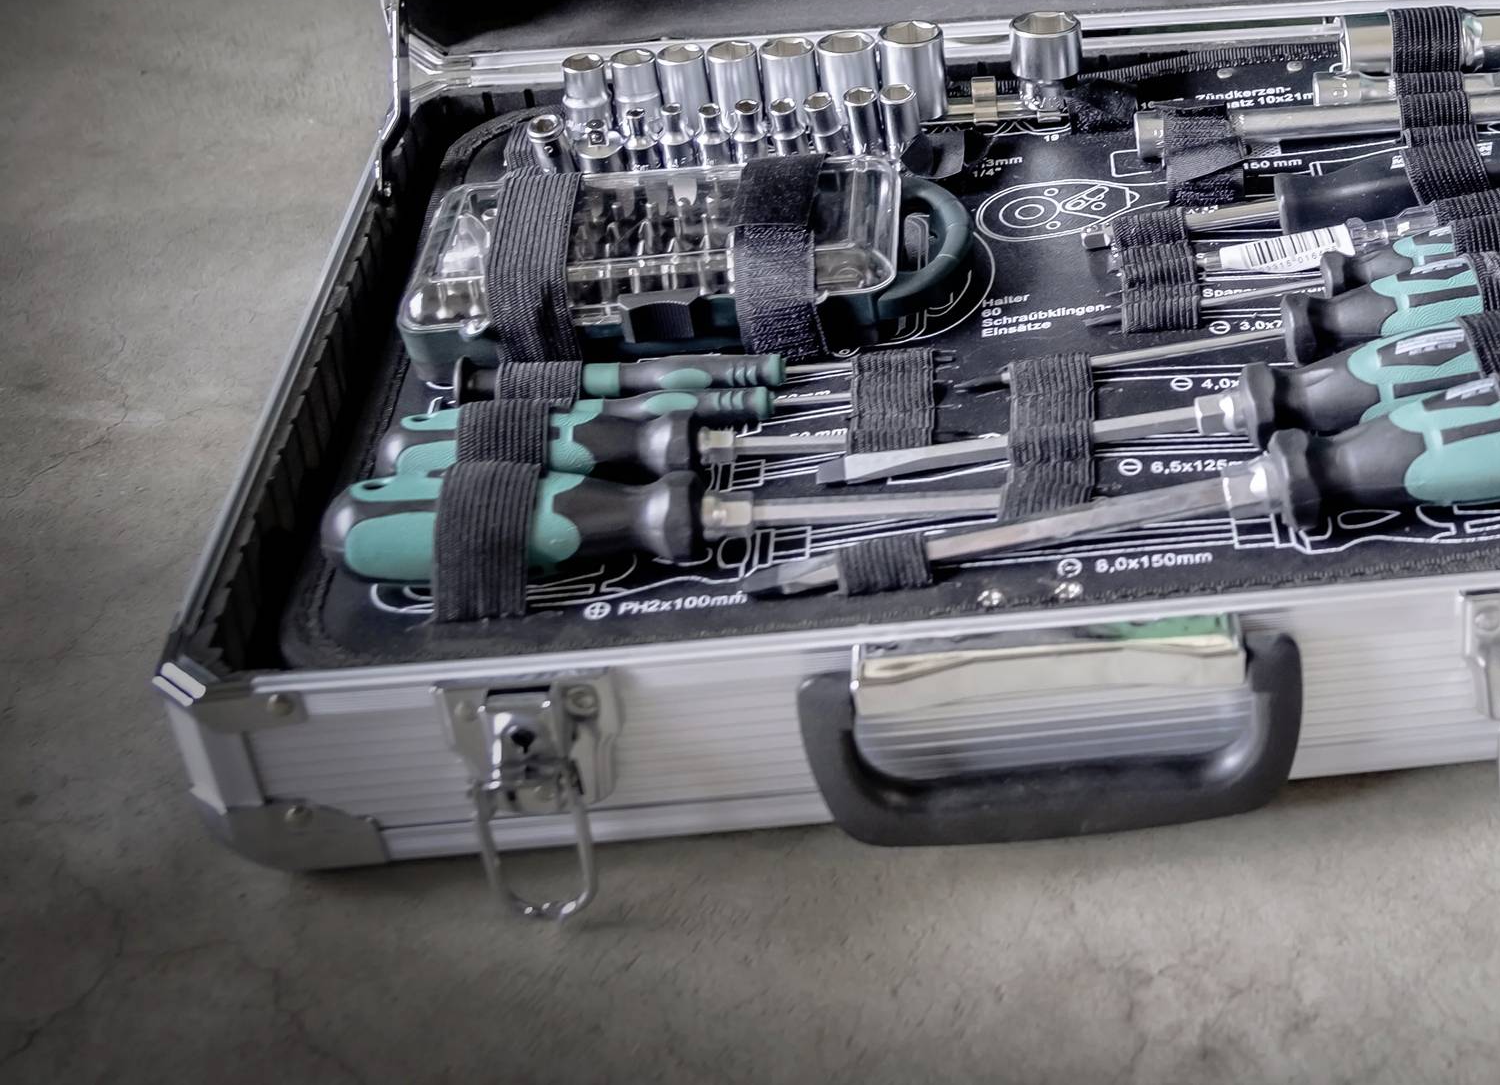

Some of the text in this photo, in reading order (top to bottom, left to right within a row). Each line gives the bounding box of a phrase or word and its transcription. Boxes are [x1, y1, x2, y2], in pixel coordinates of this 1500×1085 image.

[1273, 159, 1302, 168] mm
[982, 293, 1031, 307] Halter
[1239, 320, 1283, 331] 3,0x7
[1201, 378, 1240, 391] 4,0x
[1094, 551, 1213, 574] 8,0x150mm
[616, 590, 749, 616] PH2x100mm
